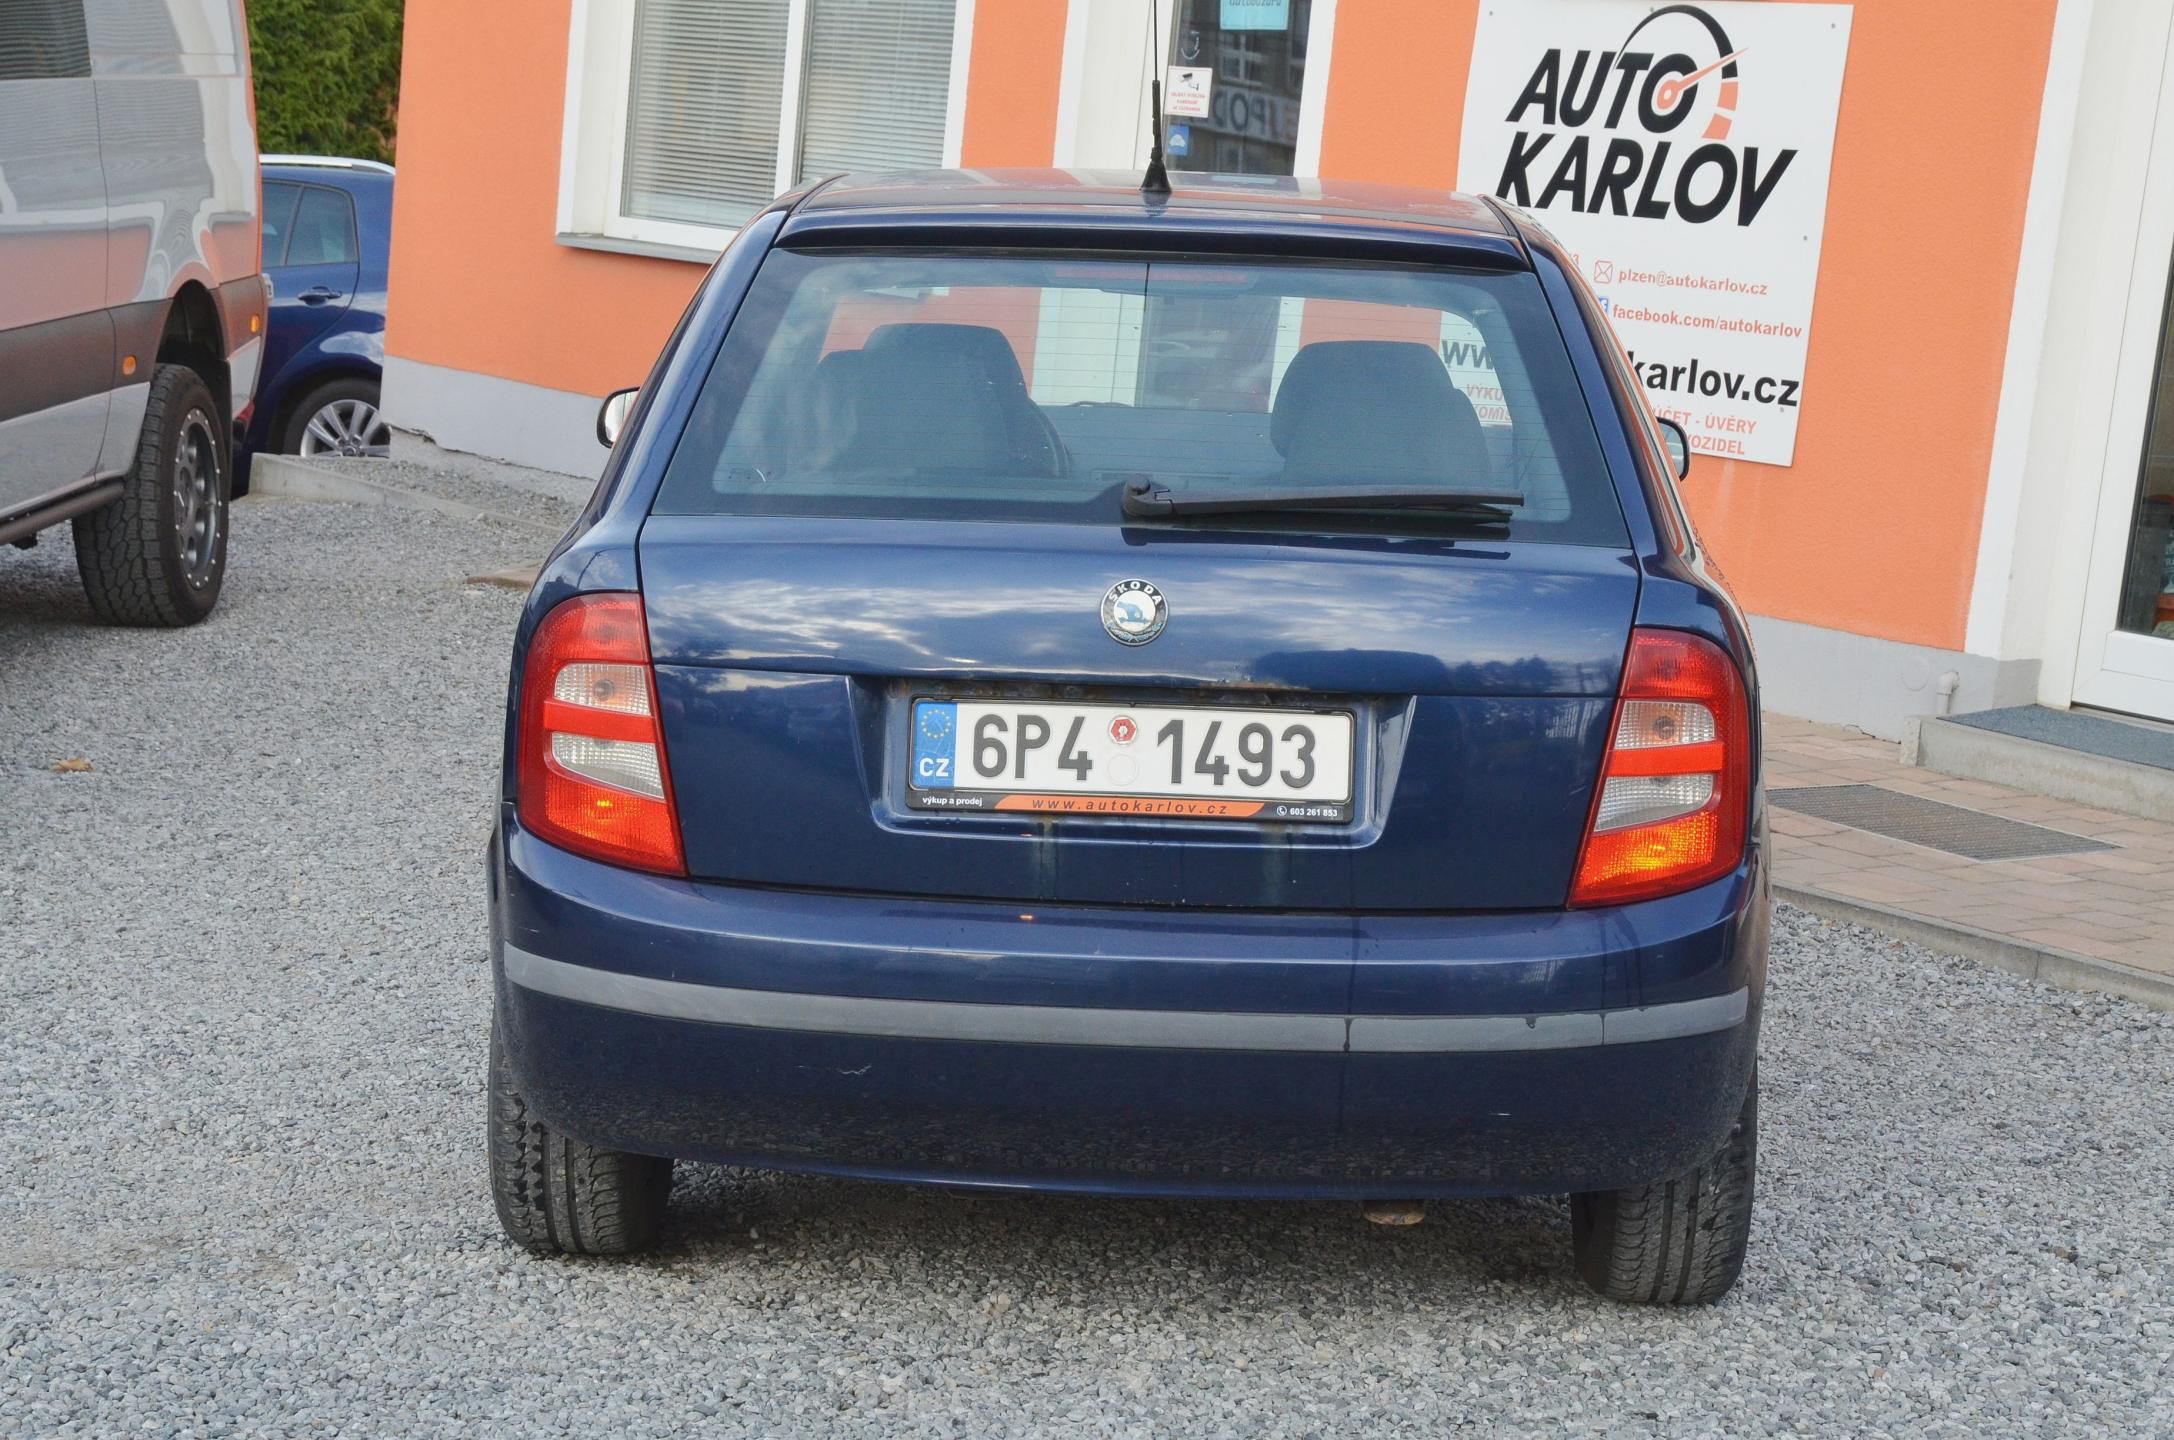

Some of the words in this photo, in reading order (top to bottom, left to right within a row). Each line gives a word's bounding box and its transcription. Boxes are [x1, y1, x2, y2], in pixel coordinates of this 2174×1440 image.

[1505, 47, 1699, 134] AUTO
[1496, 131, 1799, 227] KARLOV
[1618, 268, 1768, 296] plzen@autokarlov.cz
[1612, 304, 1802, 338] facebook.com/autokarlov
[1705, 411, 1757, 435] ÚVĚRY
[972, 712, 1094, 782] 6P4
[1156, 718, 1316, 789] 1493
[918, 755, 950, 778] CZ
[922, 796, 947, 806] výkup
[956, 796, 983, 807] prodej
[1032, 797, 1228, 815] www.autokarlov.cz
[1289, 807, 1305, 816] 603
[1307, 808, 1321, 817] 261
